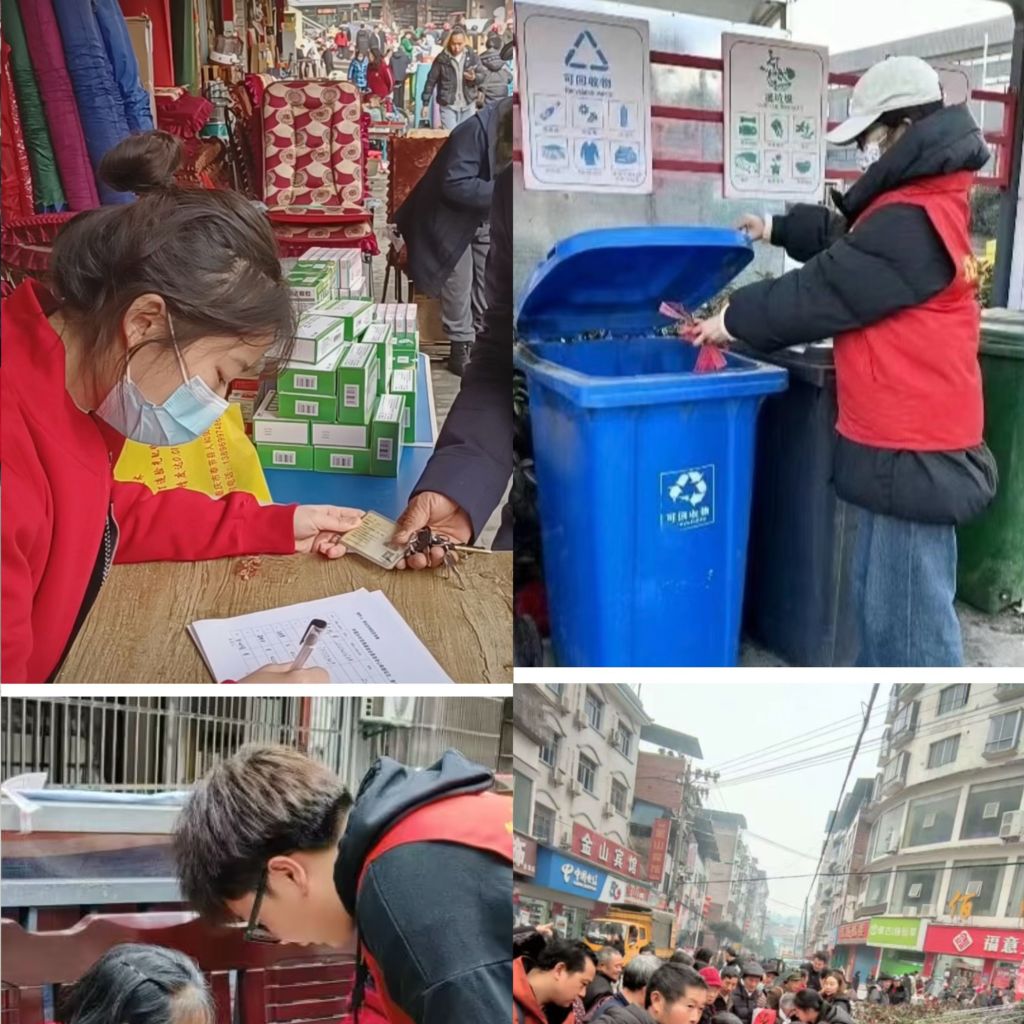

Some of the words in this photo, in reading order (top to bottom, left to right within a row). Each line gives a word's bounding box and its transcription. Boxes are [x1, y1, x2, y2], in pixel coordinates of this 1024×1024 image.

[563, 73, 612, 89] 可回收物
[580, 832, 639, 876] 金山宾馆
[983, 935, 1024, 955] 福意
